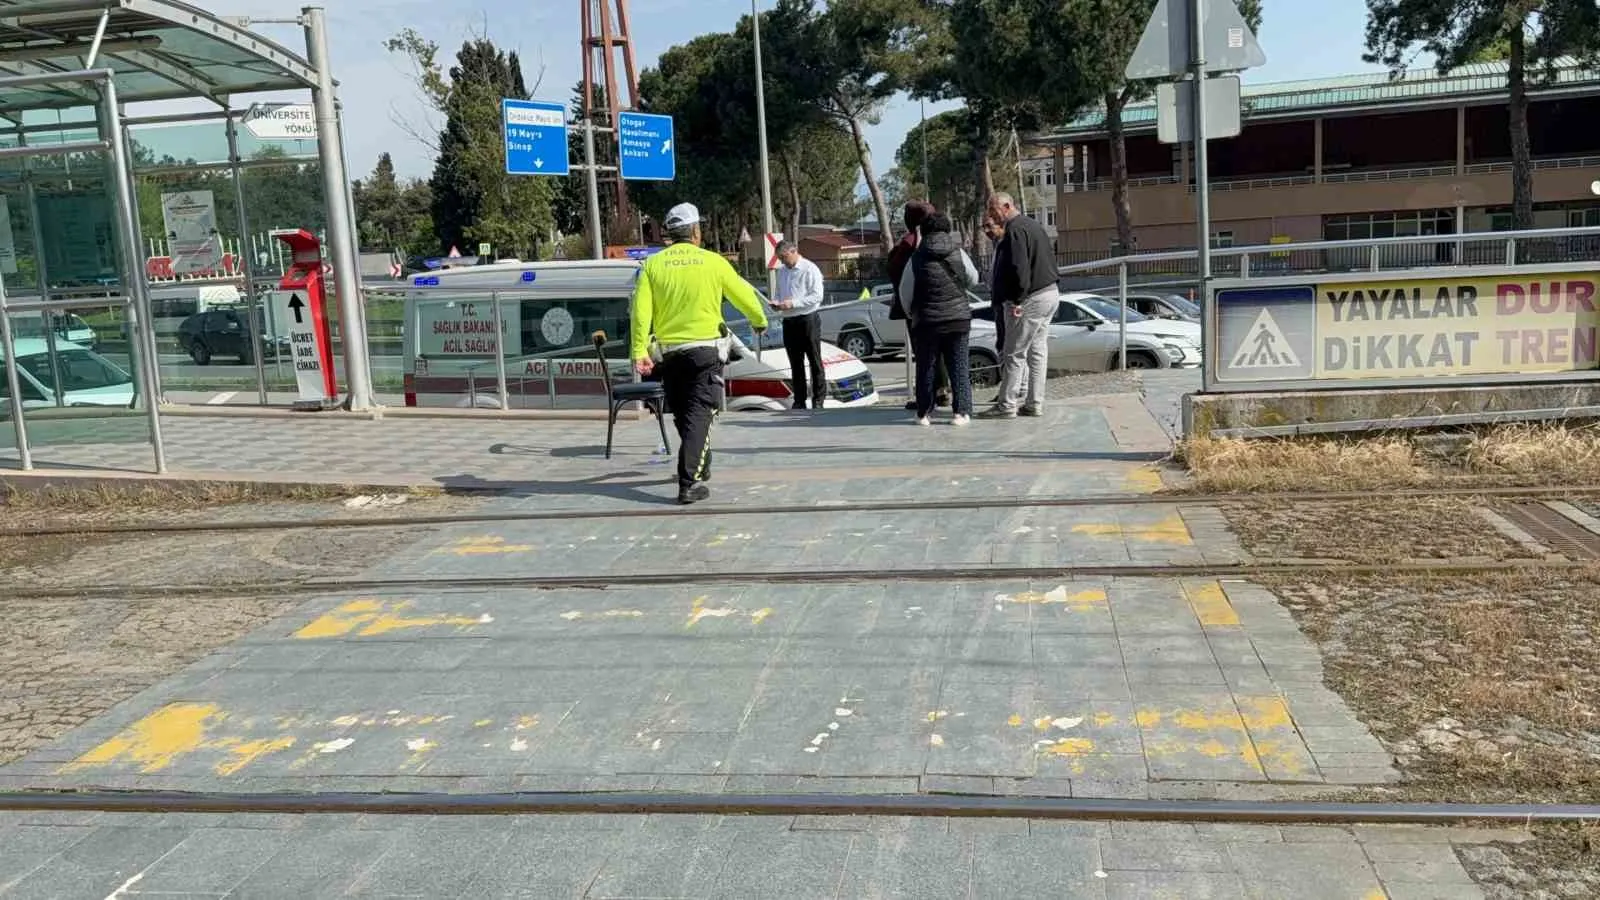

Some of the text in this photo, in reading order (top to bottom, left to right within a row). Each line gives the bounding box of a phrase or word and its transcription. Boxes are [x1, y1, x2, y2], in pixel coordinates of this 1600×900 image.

[253, 107, 310, 119] ÜNİVERSİTE
[285, 122, 311, 133] YÖNÜ
[621, 117, 645, 127] Otogar
[508, 128, 517, 137] 19
[623, 139, 651, 149] Amasya
[624, 149, 649, 157] Ankara
[1325, 280, 1597, 322] YAYALAR DUR
[461, 303, 477, 316] T.C.
[291, 331, 313, 342] ÜCRET
[1496, 327, 1598, 365] TREN
